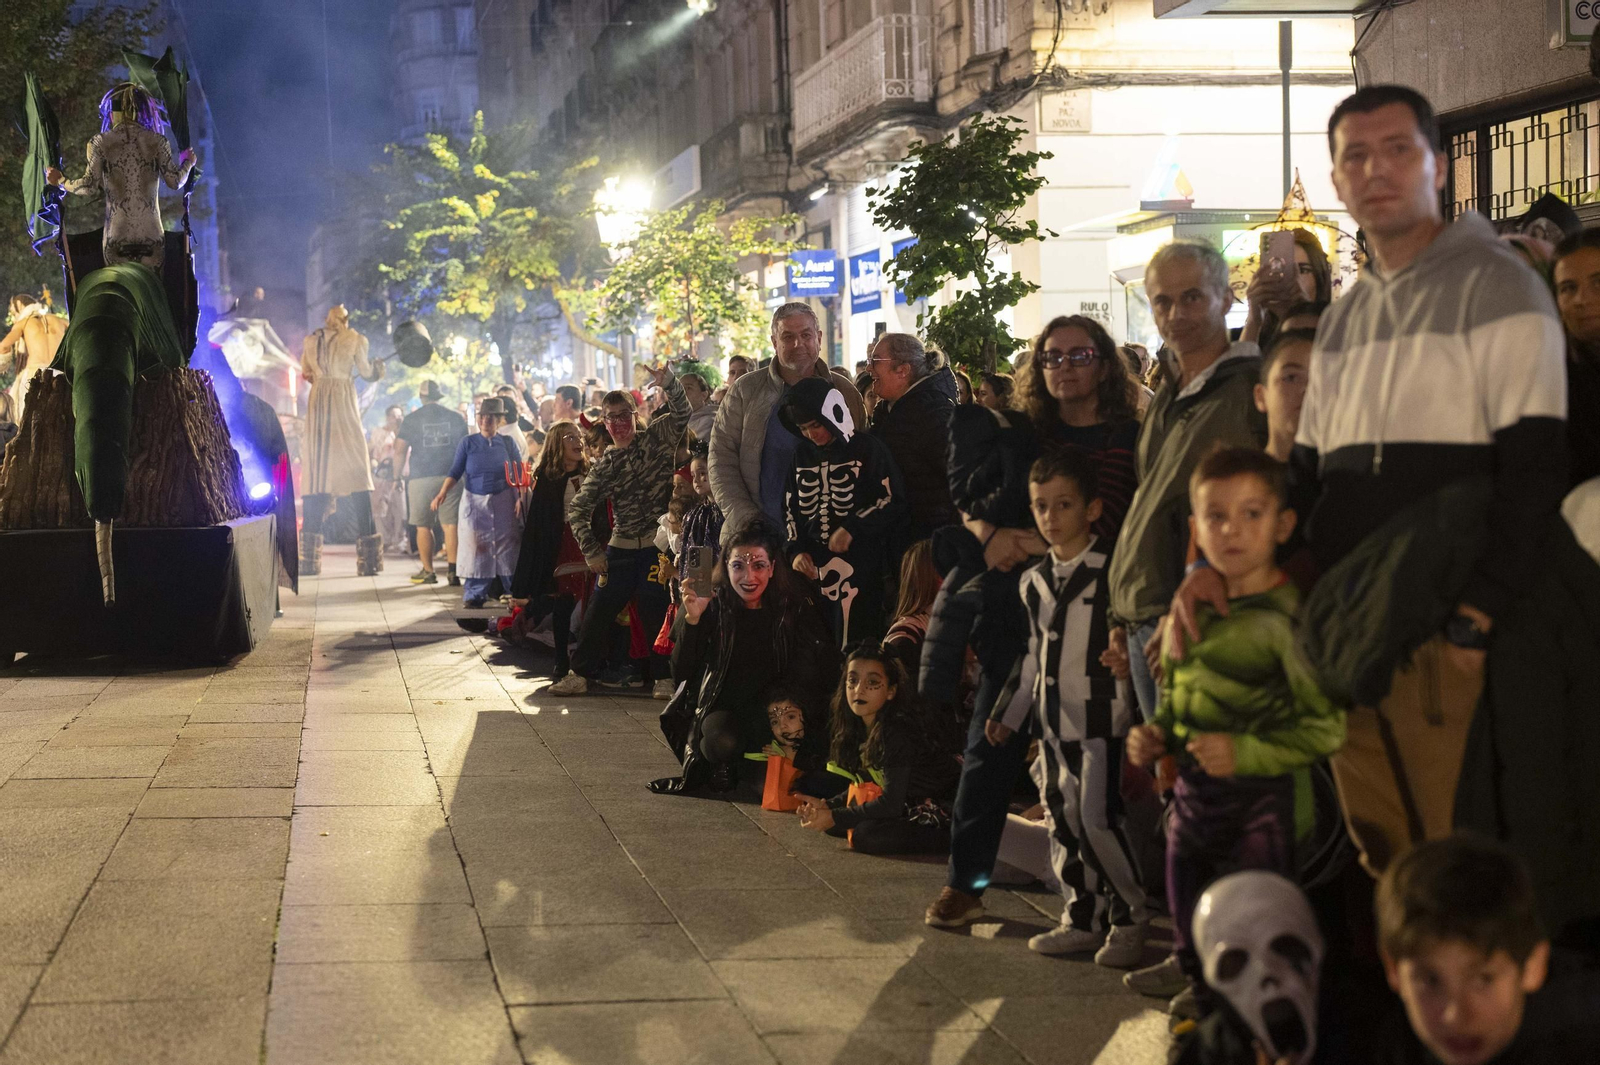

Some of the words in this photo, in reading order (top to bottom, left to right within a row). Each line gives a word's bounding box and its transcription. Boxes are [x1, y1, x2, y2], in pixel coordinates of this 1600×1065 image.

[1058, 107, 1075, 117] PAZ
[1052, 119, 1082, 128] NOVOA
[804, 259, 835, 273] Aural
[1080, 301, 1109, 312] RULO
